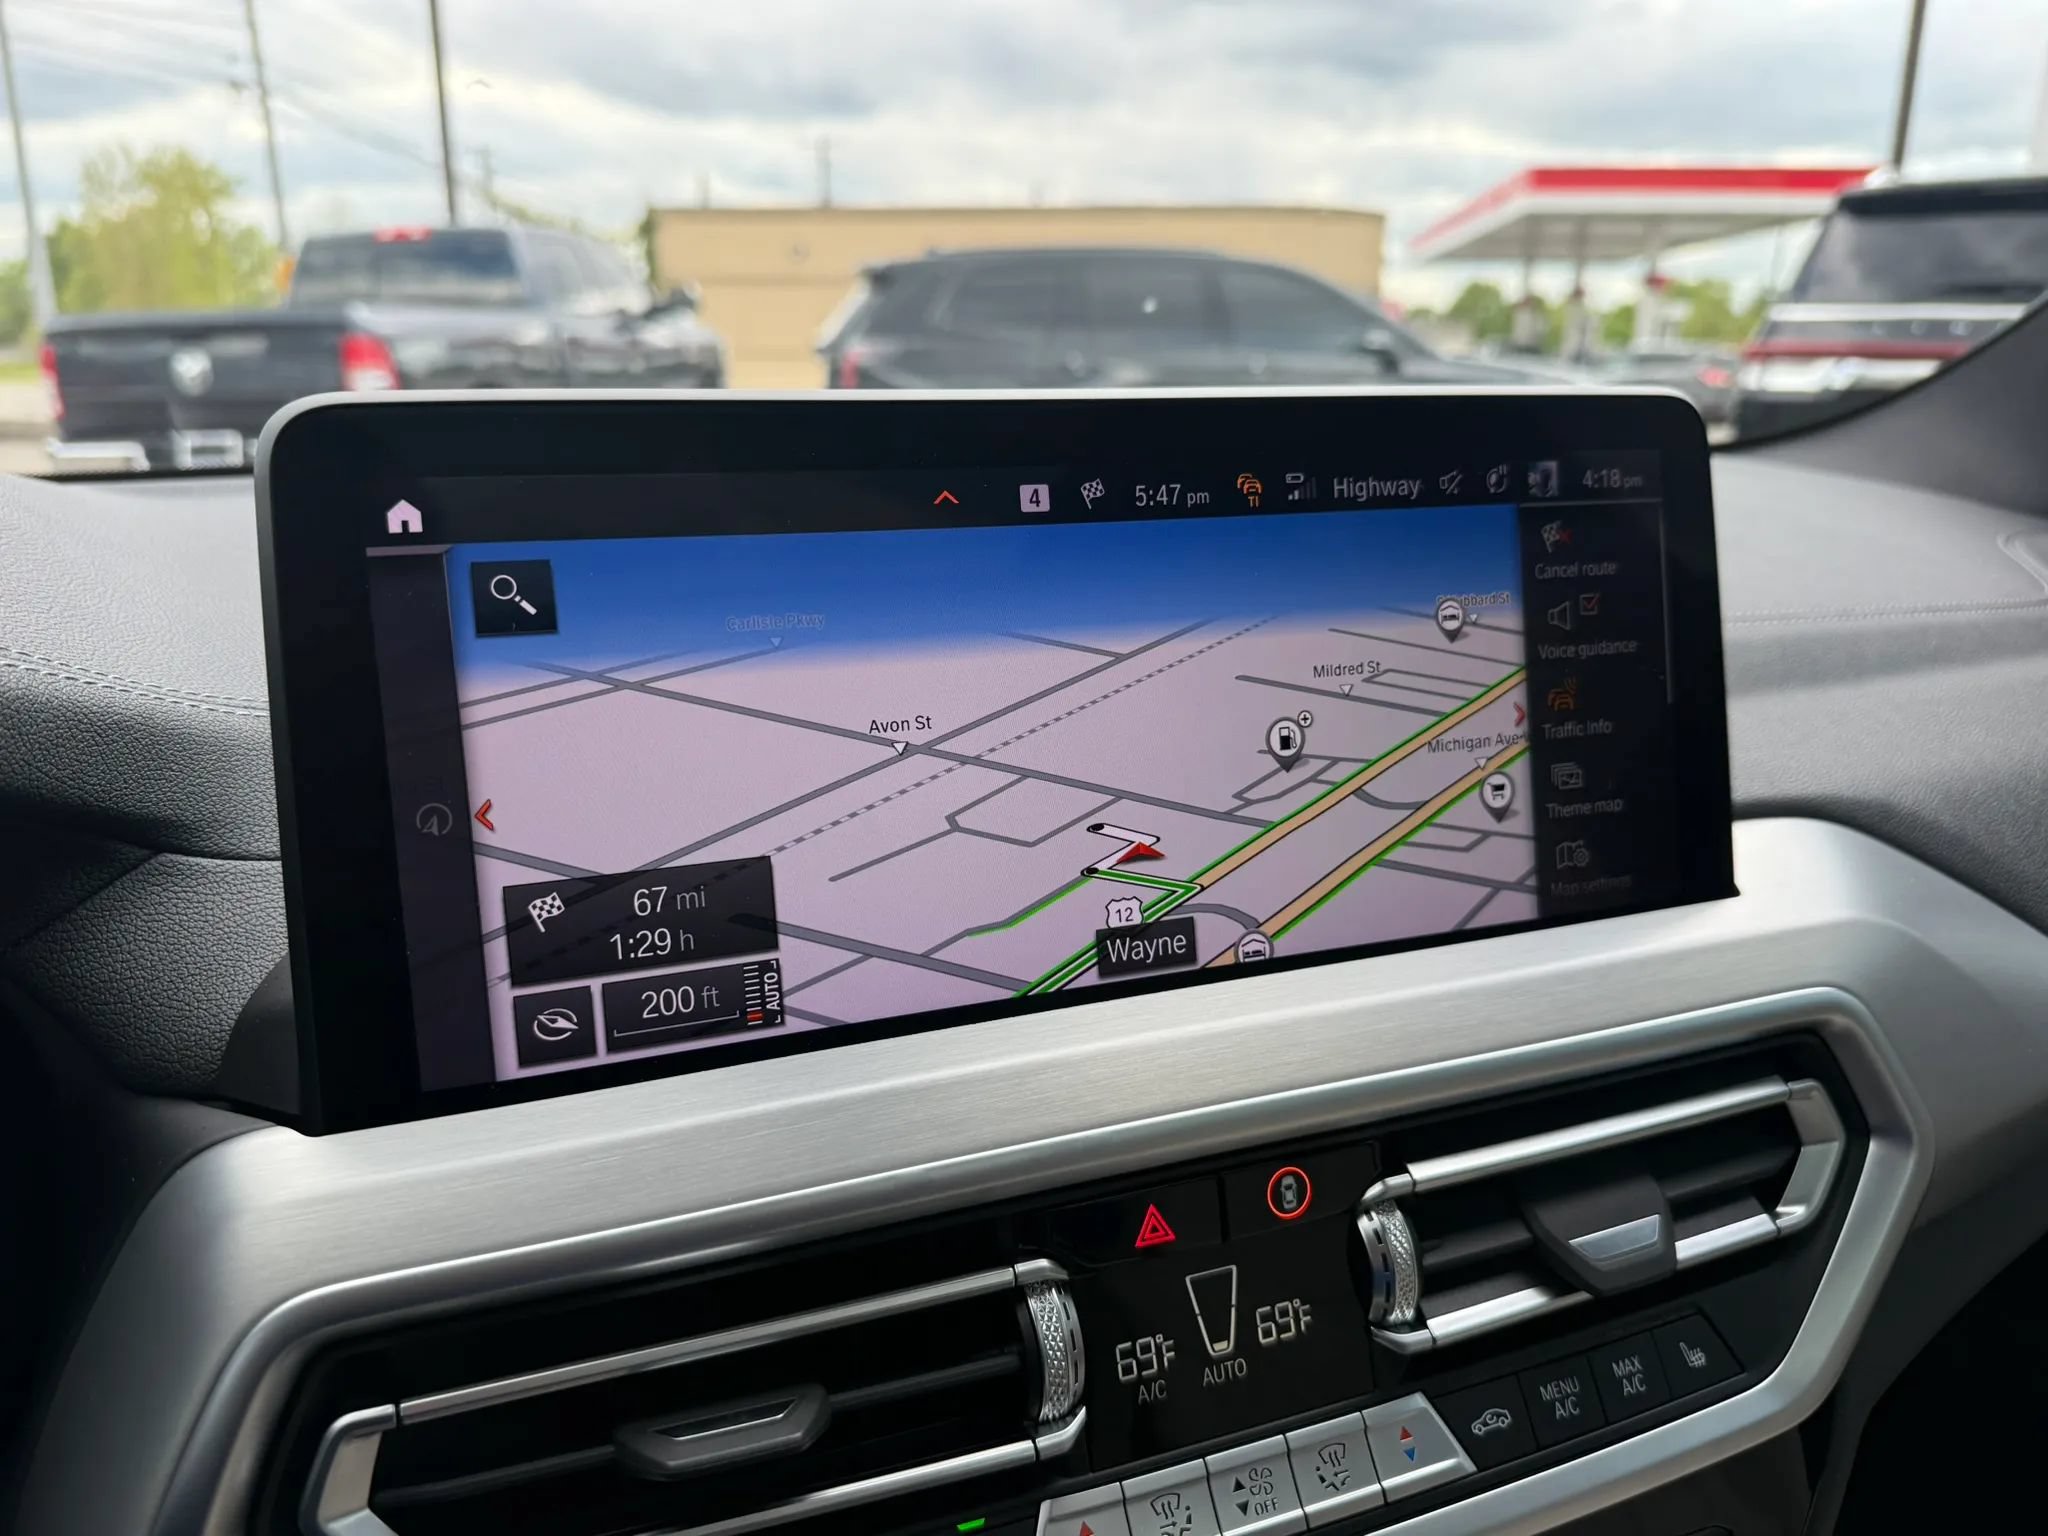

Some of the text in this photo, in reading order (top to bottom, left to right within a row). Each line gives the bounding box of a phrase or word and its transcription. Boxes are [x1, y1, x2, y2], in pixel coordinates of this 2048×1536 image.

[1333, 477, 1420, 502] Highway
[1582, 469, 1643, 490] 4:18 pm
[1028, 488, 1041, 507] 4
[1135, 484, 1209, 507] 5:47 pm
[1535, 561, 1616, 579] Cancel route
[727, 613, 824, 631] Carlisle Pkwy
[1537, 640, 1638, 660] Voice guidance
[1313, 660, 1381, 678] Mildred St
[868, 714, 932, 734] Avon St
[1541, 719, 1612, 740] Traffic Info
[1427, 735, 1491, 753] Michigan
[1545, 798, 1624, 819] Theme map
[632, 885, 706, 917] 67 mi
[1115, 907, 1134, 923] 12
[609, 928, 695, 961] 1:29 h
[1106, 934, 1187, 963] Wayne
[641, 985, 720, 1019] 200 ft
[765, 971, 781, 1011] AUTO
[1202, 1358, 1248, 1387] AUTO
[1611, 1355, 1643, 1378] MAX
[1137, 1379, 1168, 1405] A/C
[1540, 1376, 1580, 1401] MENU
[1622, 1373, 1647, 1396] A/C
[1555, 1396, 1581, 1420] A/C
[1254, 1498, 1280, 1517] OFF
